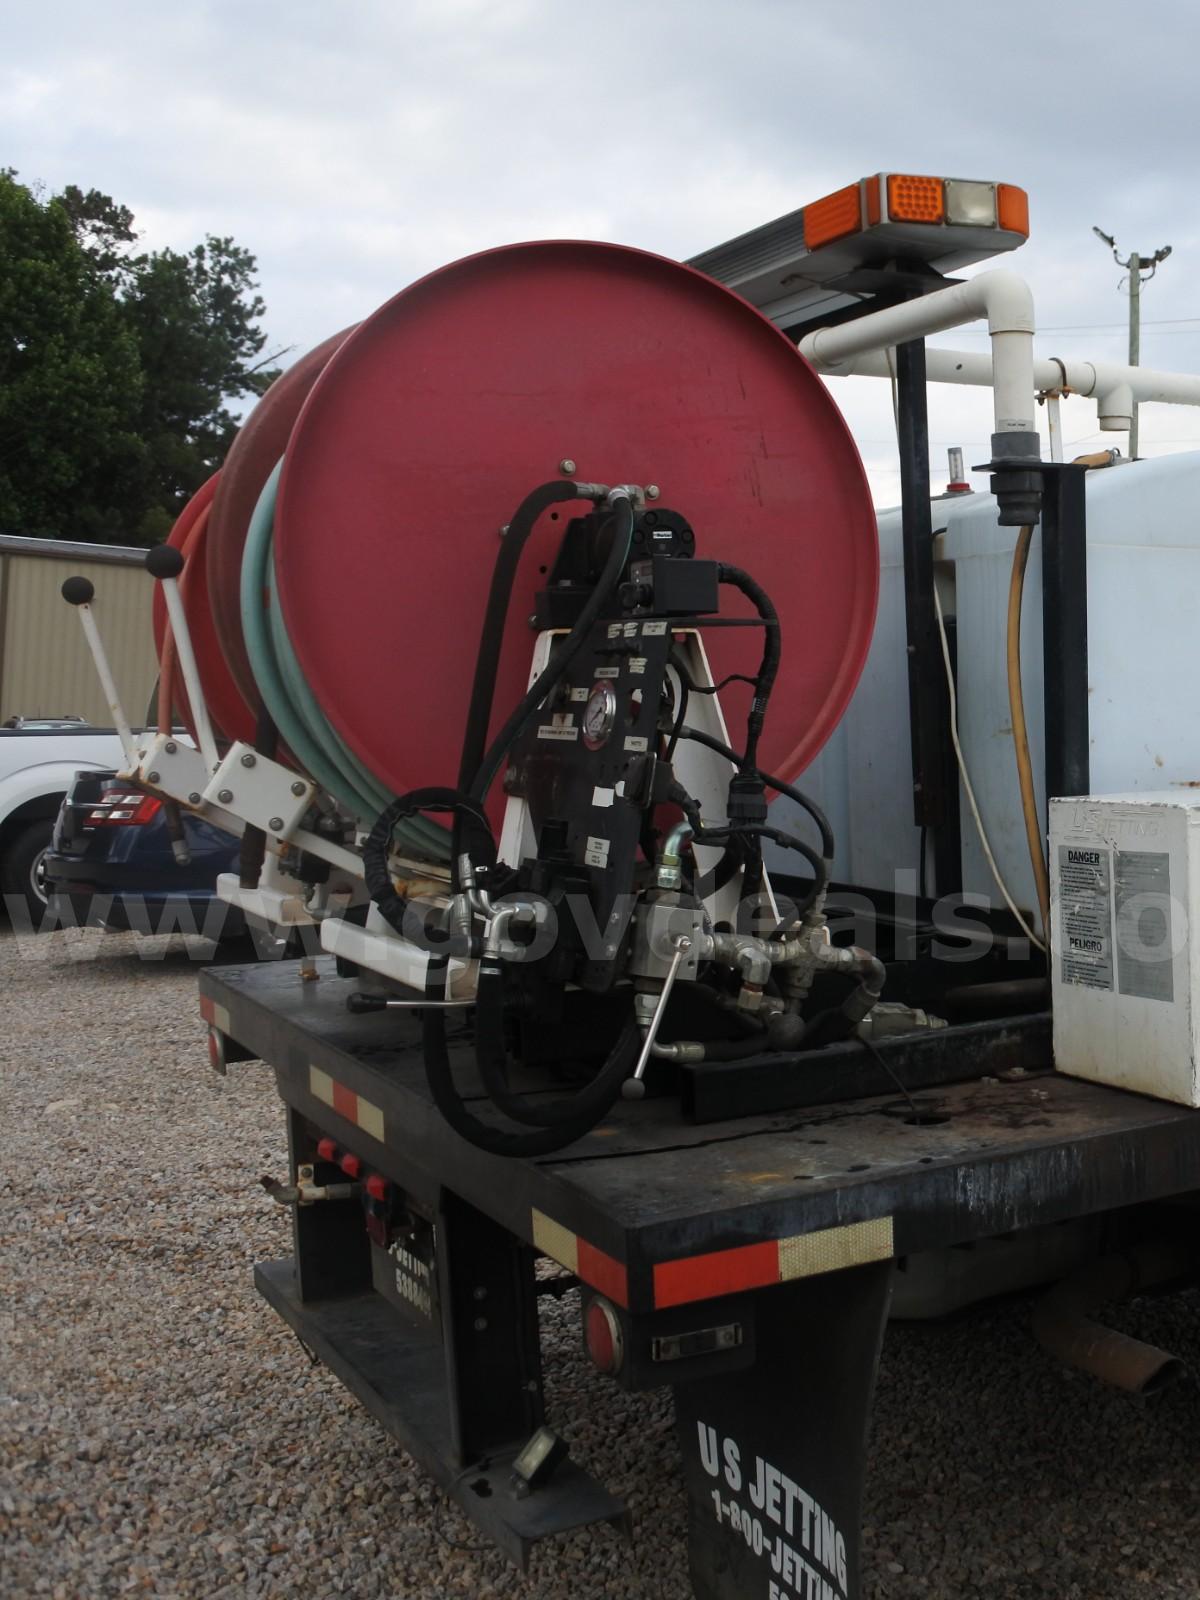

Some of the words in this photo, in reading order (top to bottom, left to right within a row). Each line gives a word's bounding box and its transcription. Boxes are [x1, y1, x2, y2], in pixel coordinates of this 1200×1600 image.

[1068, 850, 1100, 864] DANGER
[1069, 937, 1102, 952] PELIGRO
[711, 1489, 844, 1600] 1-800-JETTIN
[749, 1455, 848, 1599] JETTING
